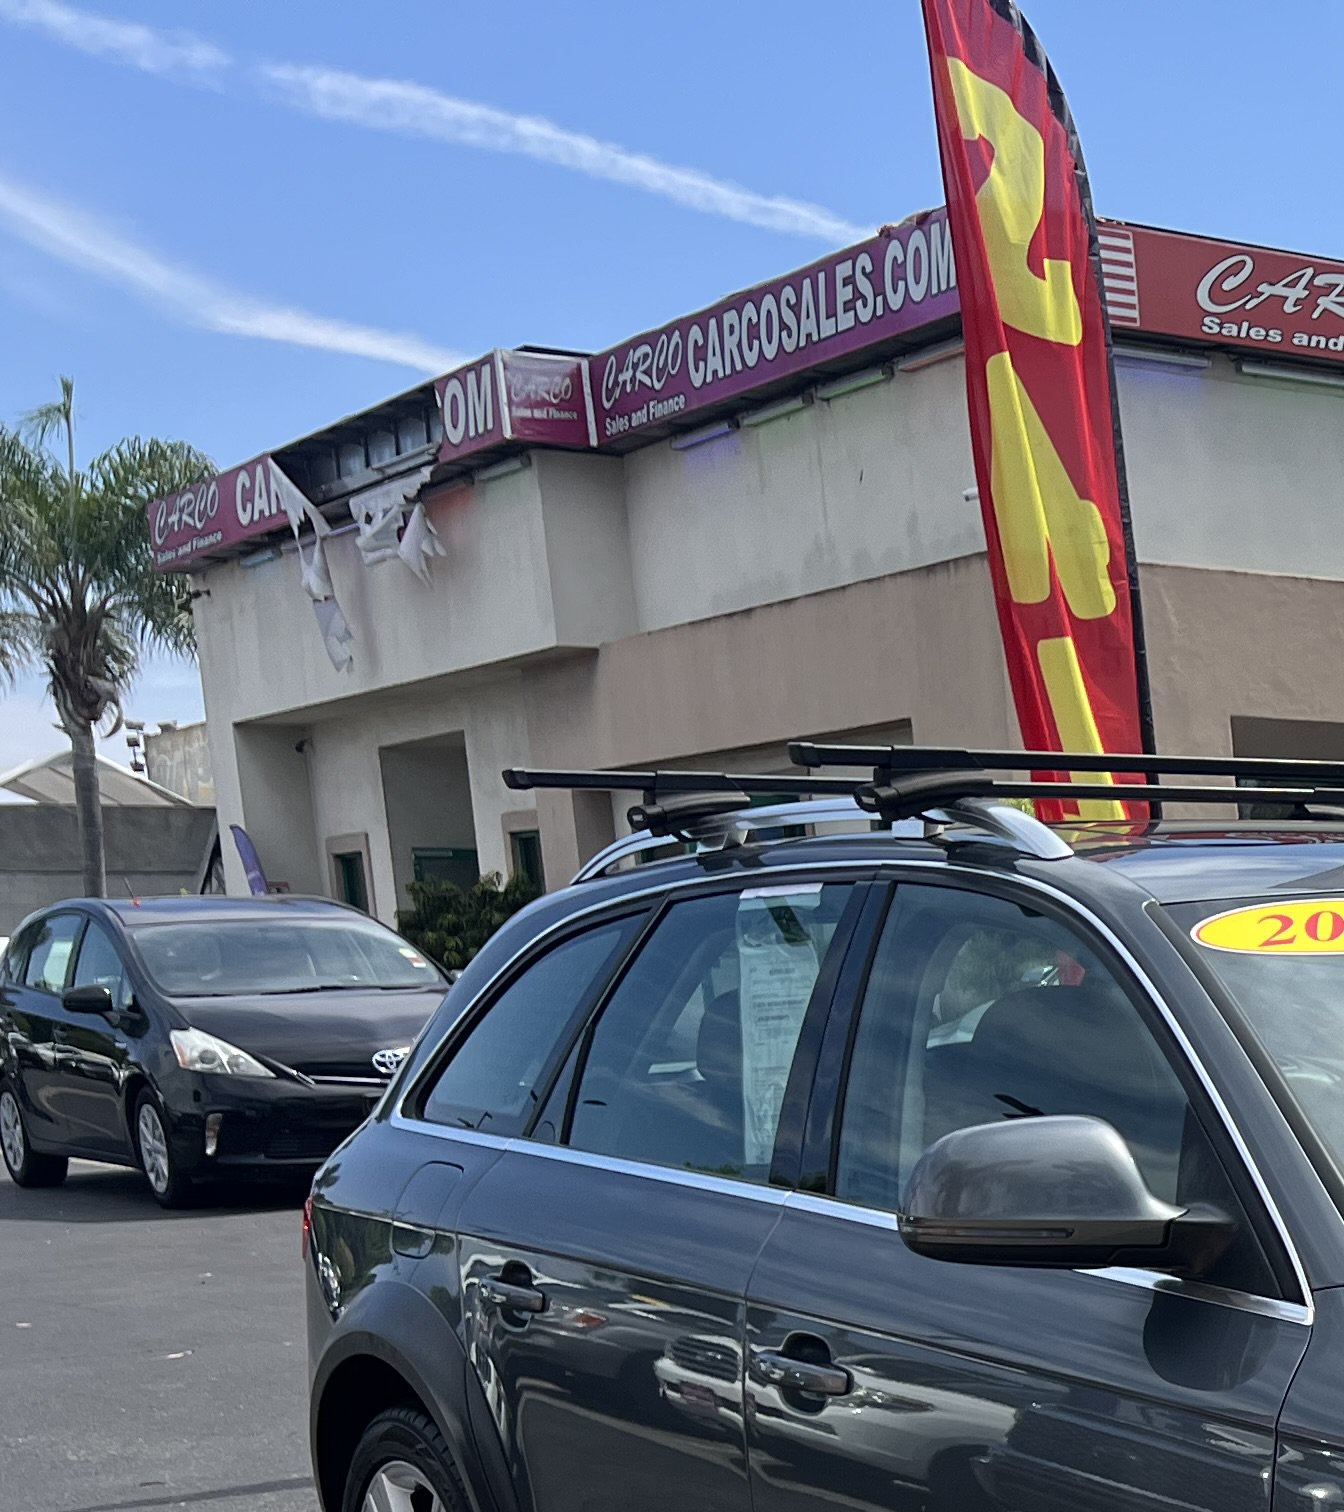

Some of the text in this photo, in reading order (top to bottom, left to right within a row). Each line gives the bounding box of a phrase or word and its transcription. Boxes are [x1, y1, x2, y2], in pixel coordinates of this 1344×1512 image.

[602, 218, 957, 410] CARCO CARCOSALES.COM
[1202, 316, 1283, 342] Sales
[1292, 332, 1344, 352] and
[603, 394, 686, 437] Sales and Finance
[155, 480, 219, 547] CARCO
